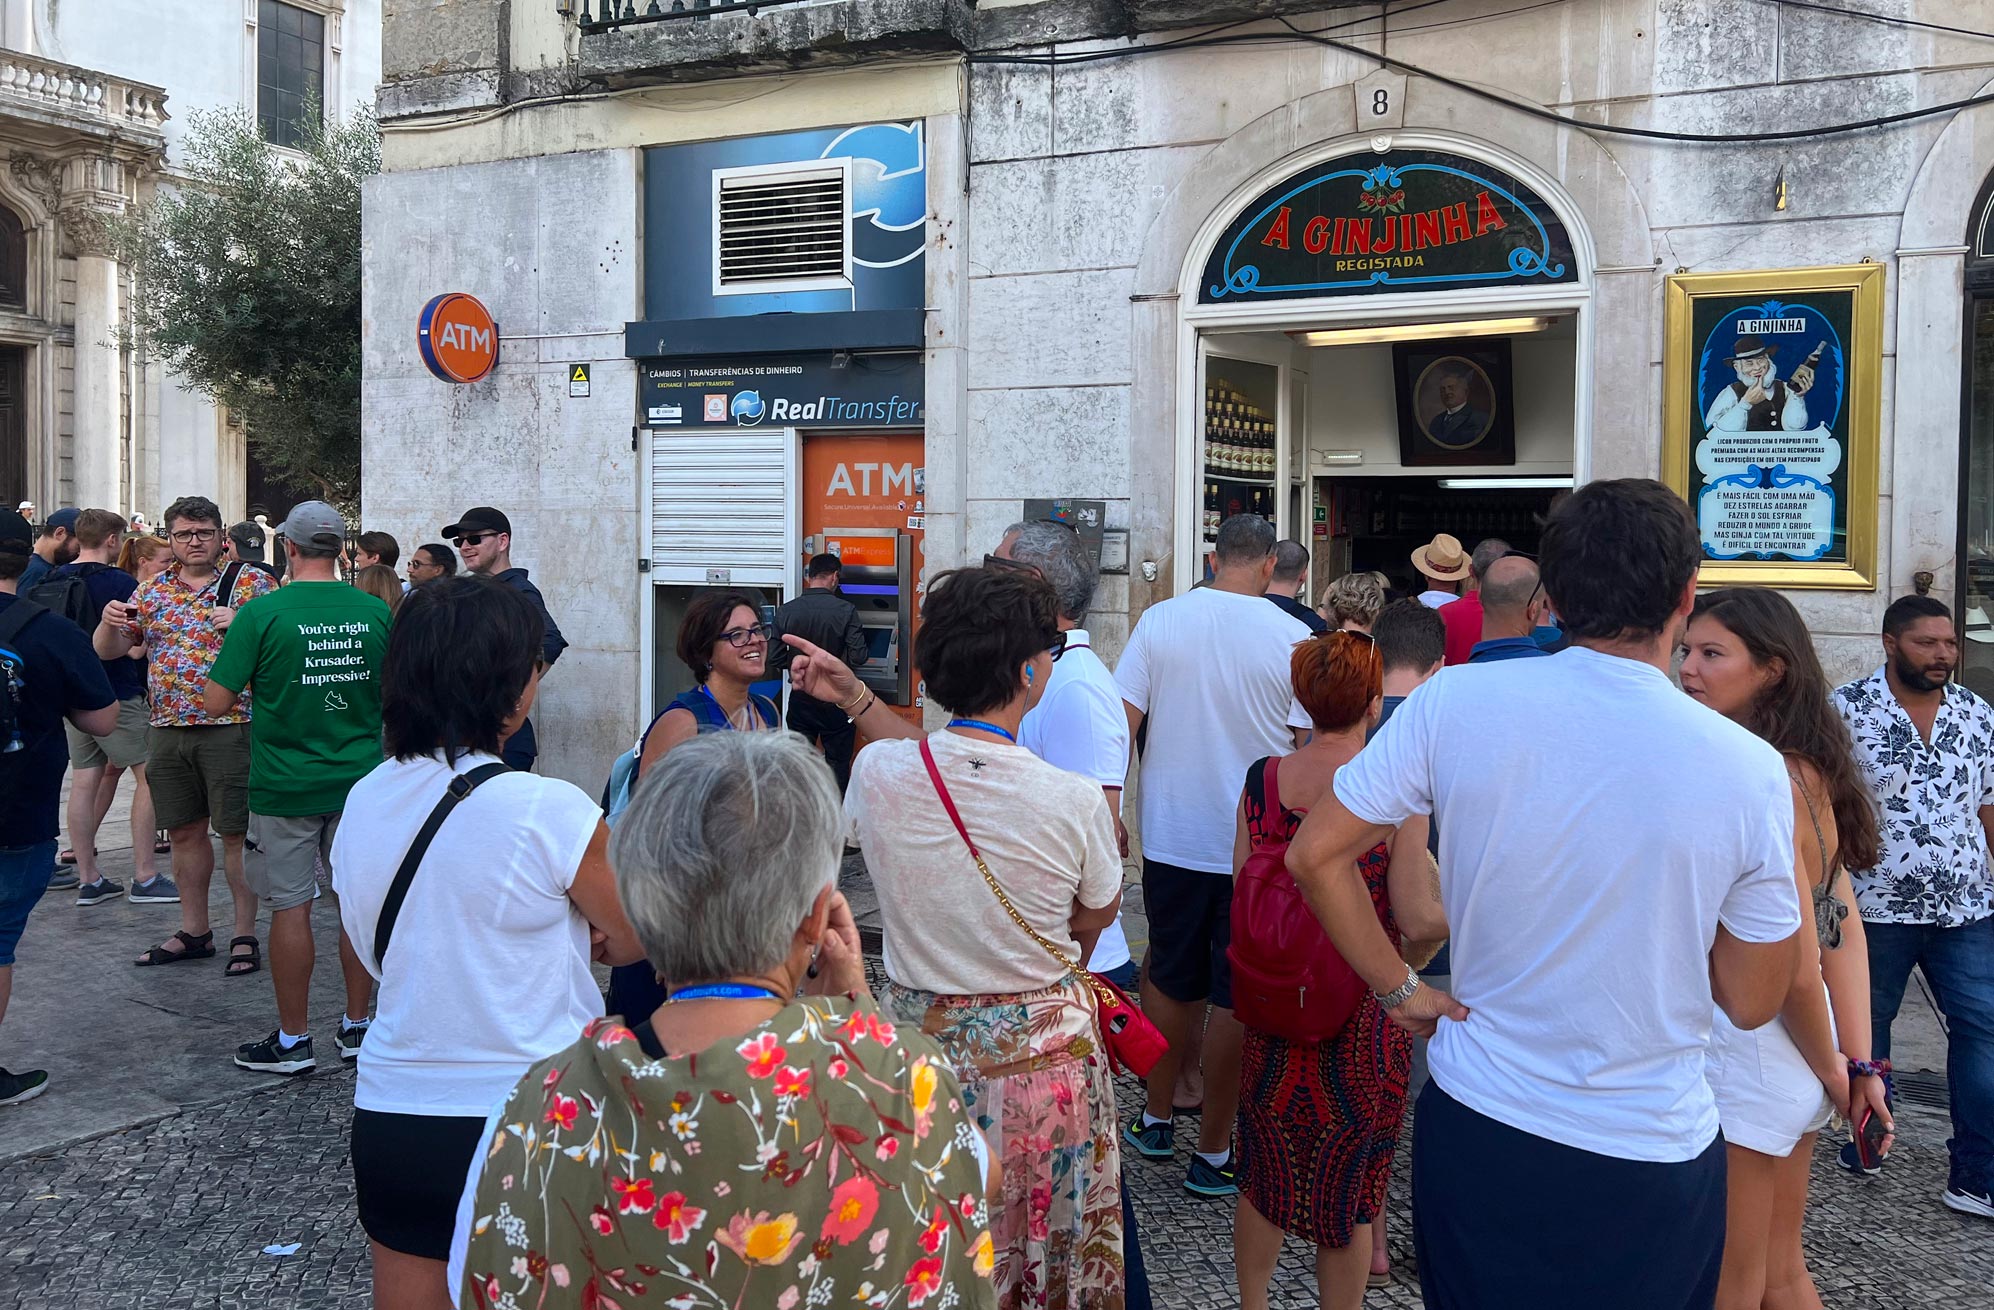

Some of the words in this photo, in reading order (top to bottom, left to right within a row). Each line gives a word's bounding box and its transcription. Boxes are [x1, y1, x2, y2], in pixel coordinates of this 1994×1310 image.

[1372, 89, 1388, 115] 8
[1261, 206, 1293, 250] A
[1302, 190, 1509, 256] GINJINHA
[1336, 255, 1424, 272] REGISTADA
[1738, 322, 1746, 332] A
[1750, 320, 1802, 334] GINJINHA
[440, 322, 490, 355] ATM
[650, 368, 681, 378] CÂMBIOS
[689, 367, 754, 377] TRANSFERÊNCIAS
[755, 367, 765, 375] DE
[766, 366, 803, 375] DINHEIRO
[826, 462, 912, 496] ATM
[1799, 491, 1815, 500] MÃO
[1722, 540, 1726, 548] É
[339, 622, 370, 636] right
[308, 638, 352, 651] behind
[354, 640, 363, 648] a
[305, 654, 365, 668] Krusader.
[302, 670, 370, 687] Impressive!
